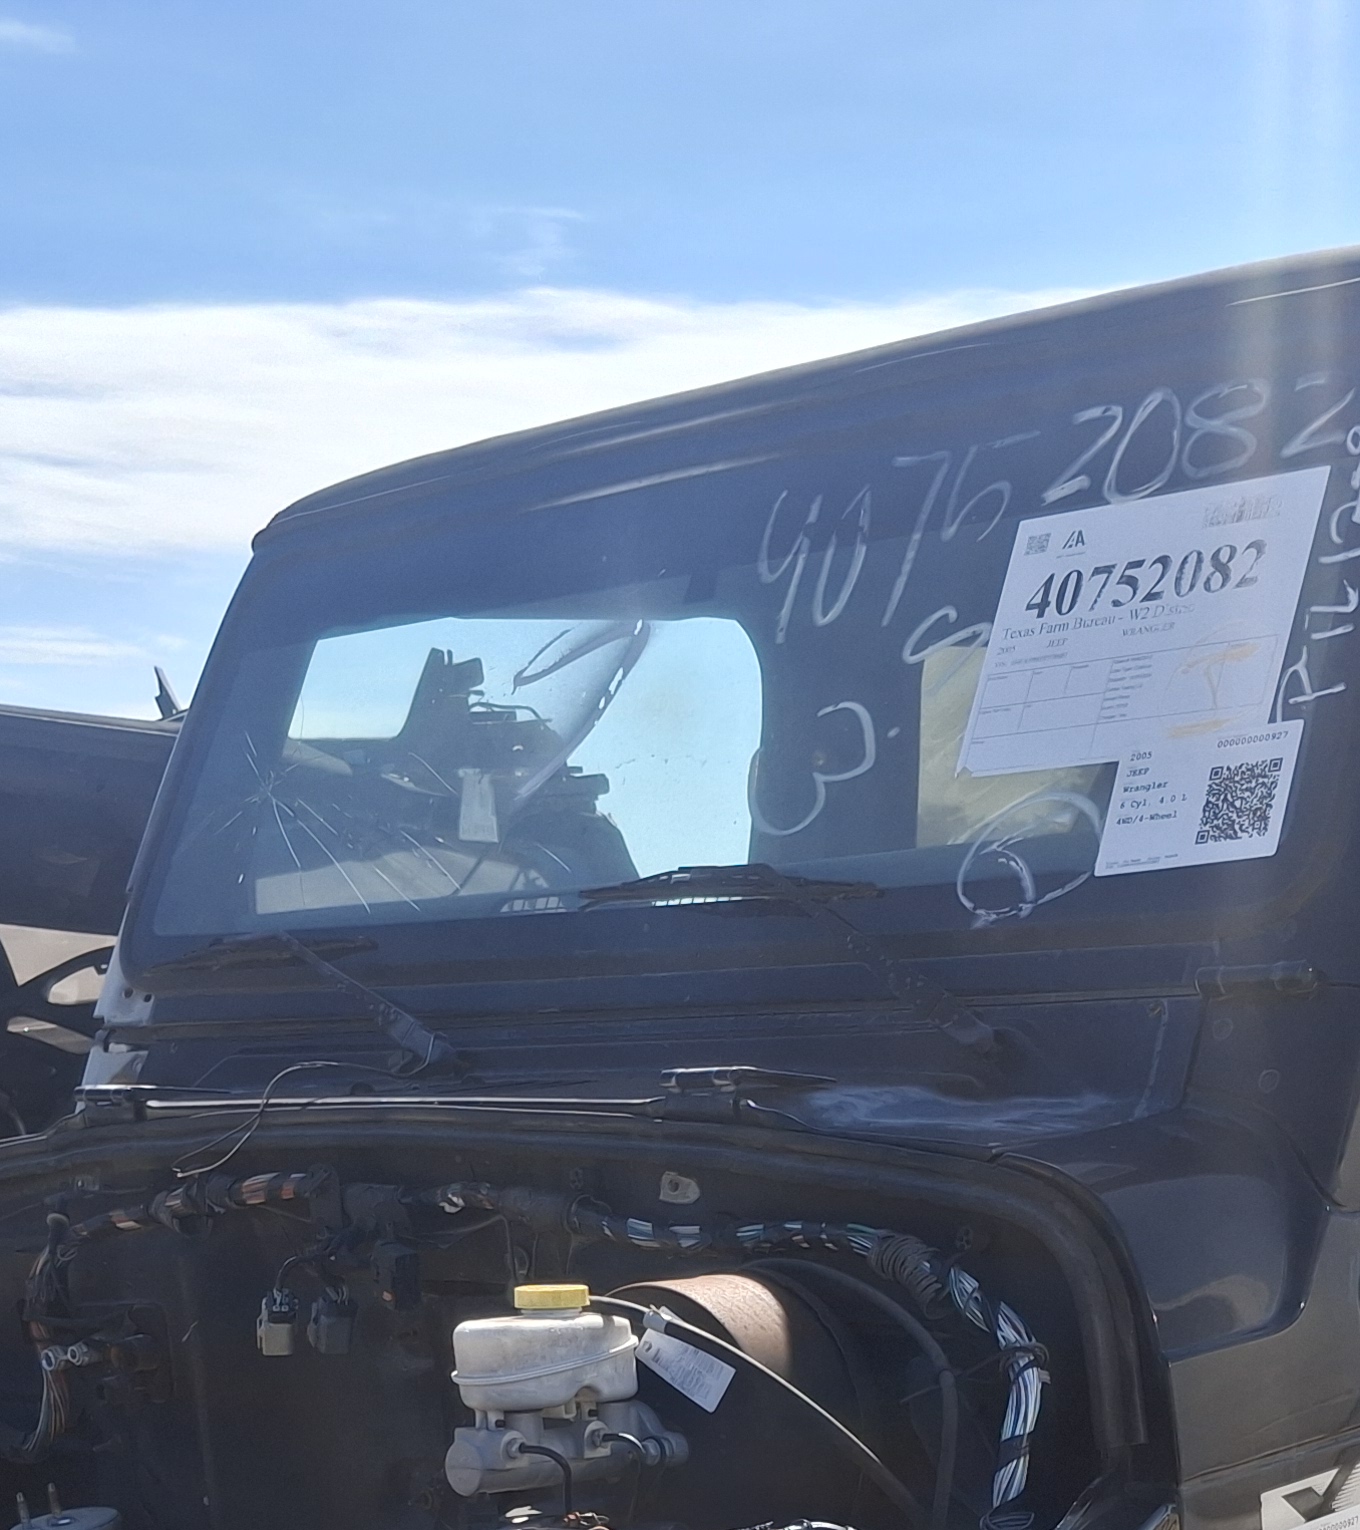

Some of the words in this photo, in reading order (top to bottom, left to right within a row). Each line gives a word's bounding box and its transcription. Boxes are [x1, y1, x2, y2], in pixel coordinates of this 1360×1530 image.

[1025, 539, 1267, 619] 40752082
[1002, 627, 1036, 640] Texas
[1039, 622, 1069, 636] Farm
[1071, 615, 1116, 631] Bureau
[1217, 730, 1289, 748] 000000000927
[1130, 751, 1152, 762] 2005
[1126, 768, 1150, 778] JEEP
[1123, 781, 1168, 793] Wrangler
